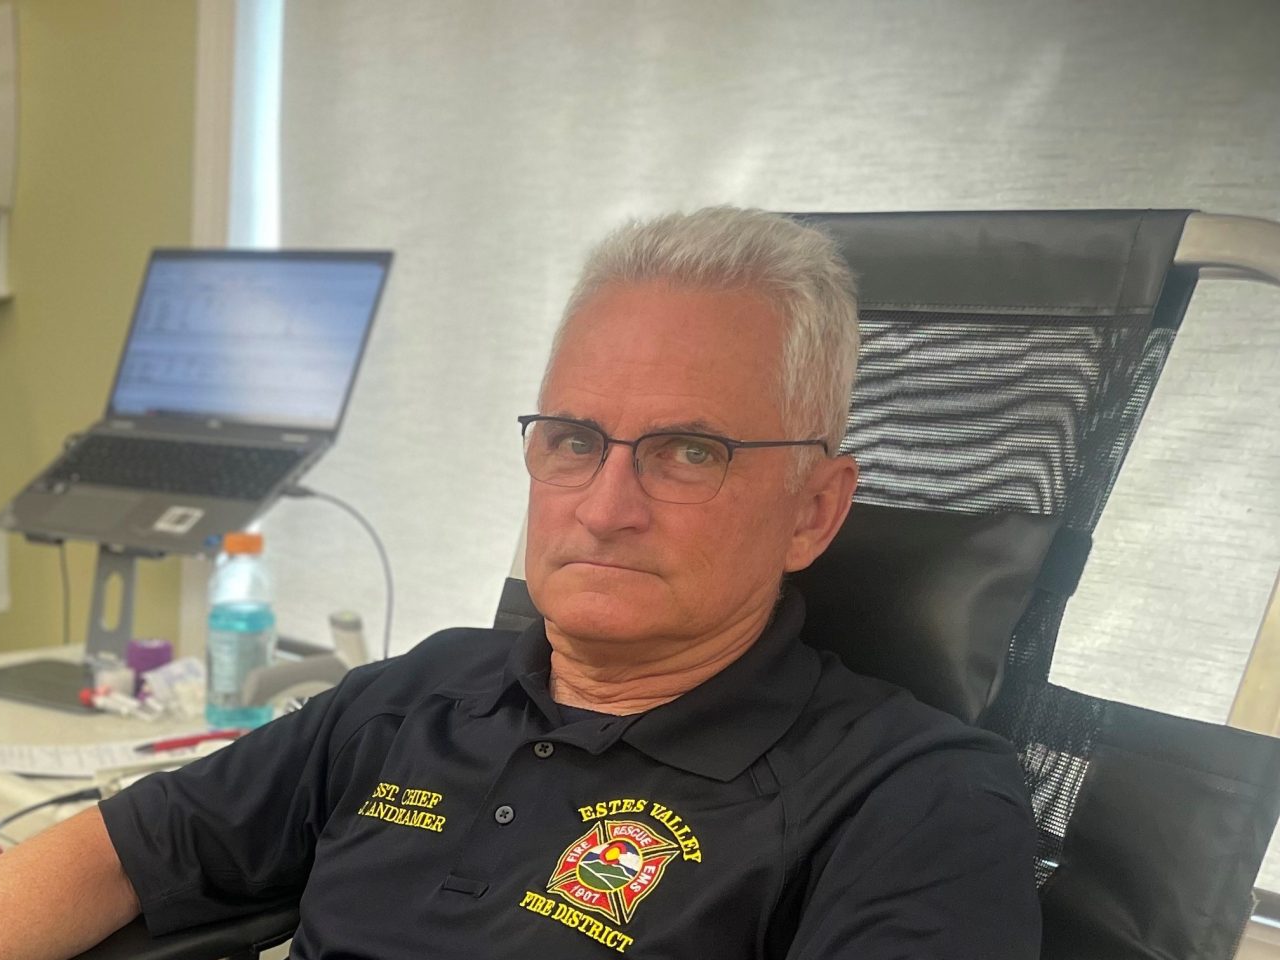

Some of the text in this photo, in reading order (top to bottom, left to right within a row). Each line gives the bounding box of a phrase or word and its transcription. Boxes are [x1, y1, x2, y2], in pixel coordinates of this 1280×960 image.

[401, 789, 443, 808] CHIEF
[578, 799, 702, 863] ESTES VALLEY
[613, 825, 652, 847] RESCUE
[566, 841, 592, 863] FIRE
[630, 865, 656, 893] EMS
[519, 891, 556, 916] FIRE
[570, 885, 601, 903] 1907
[551, 903, 634, 953] DISTRICT
